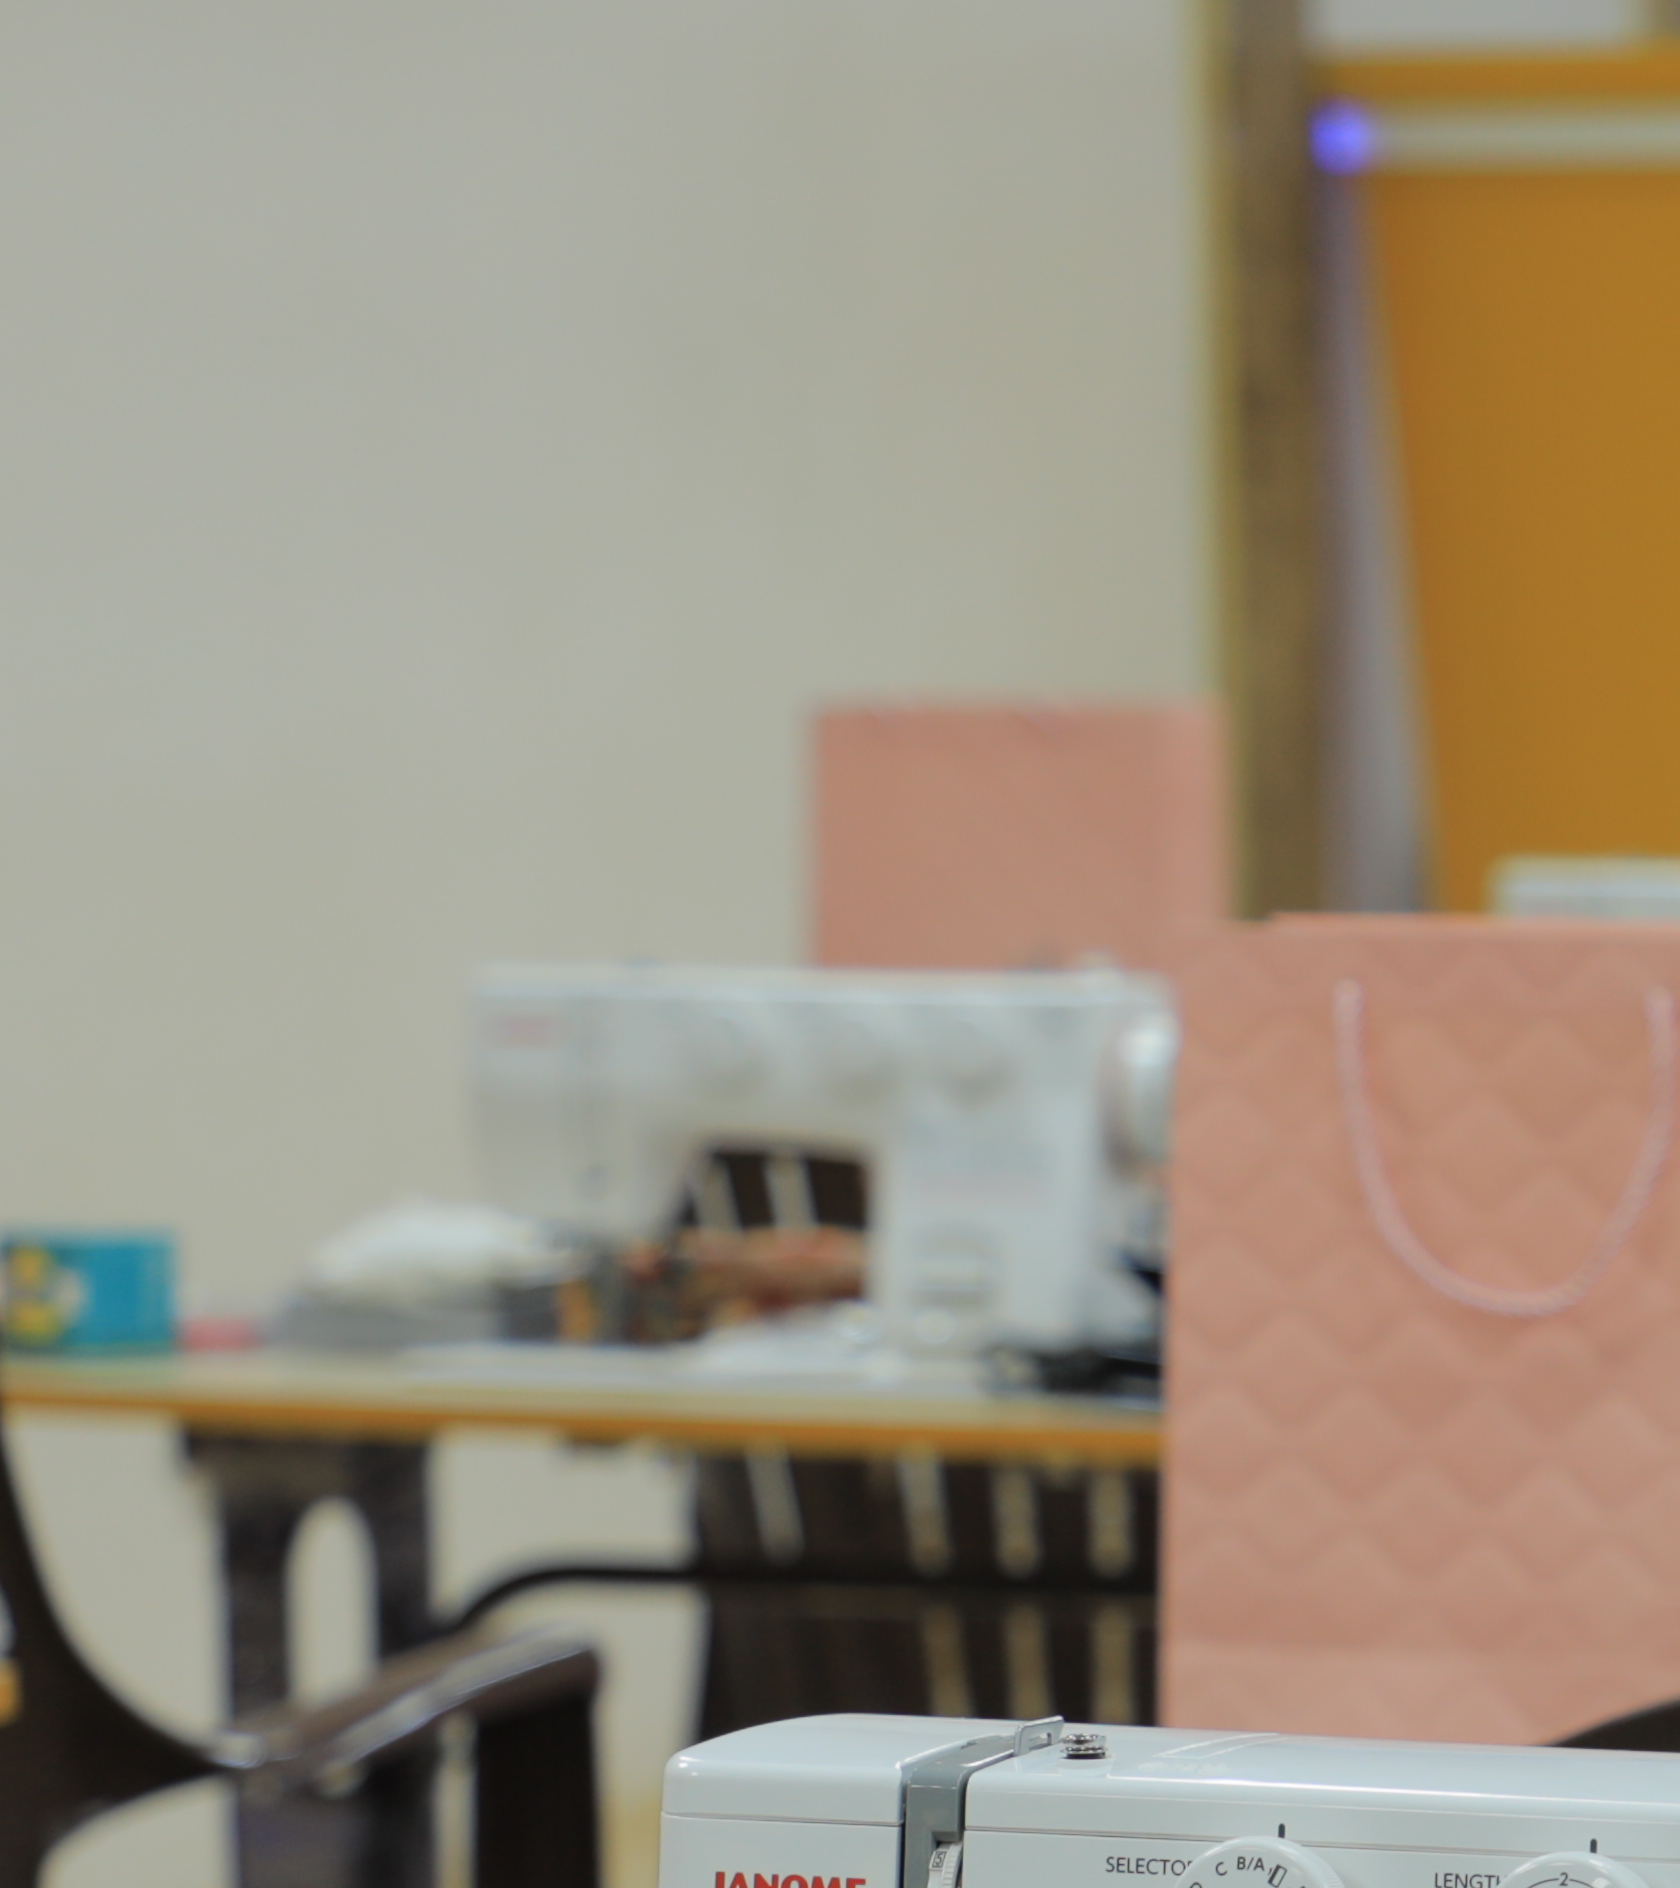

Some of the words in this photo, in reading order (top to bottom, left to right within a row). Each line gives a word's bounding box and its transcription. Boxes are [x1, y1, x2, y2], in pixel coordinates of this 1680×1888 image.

[1105, 1856, 1193, 1876] SELECTO
[1215, 1862, 1228, 1876] C
[1236, 1856, 1265, 1872] B/A
[1558, 1872, 1569, 1887] 2
